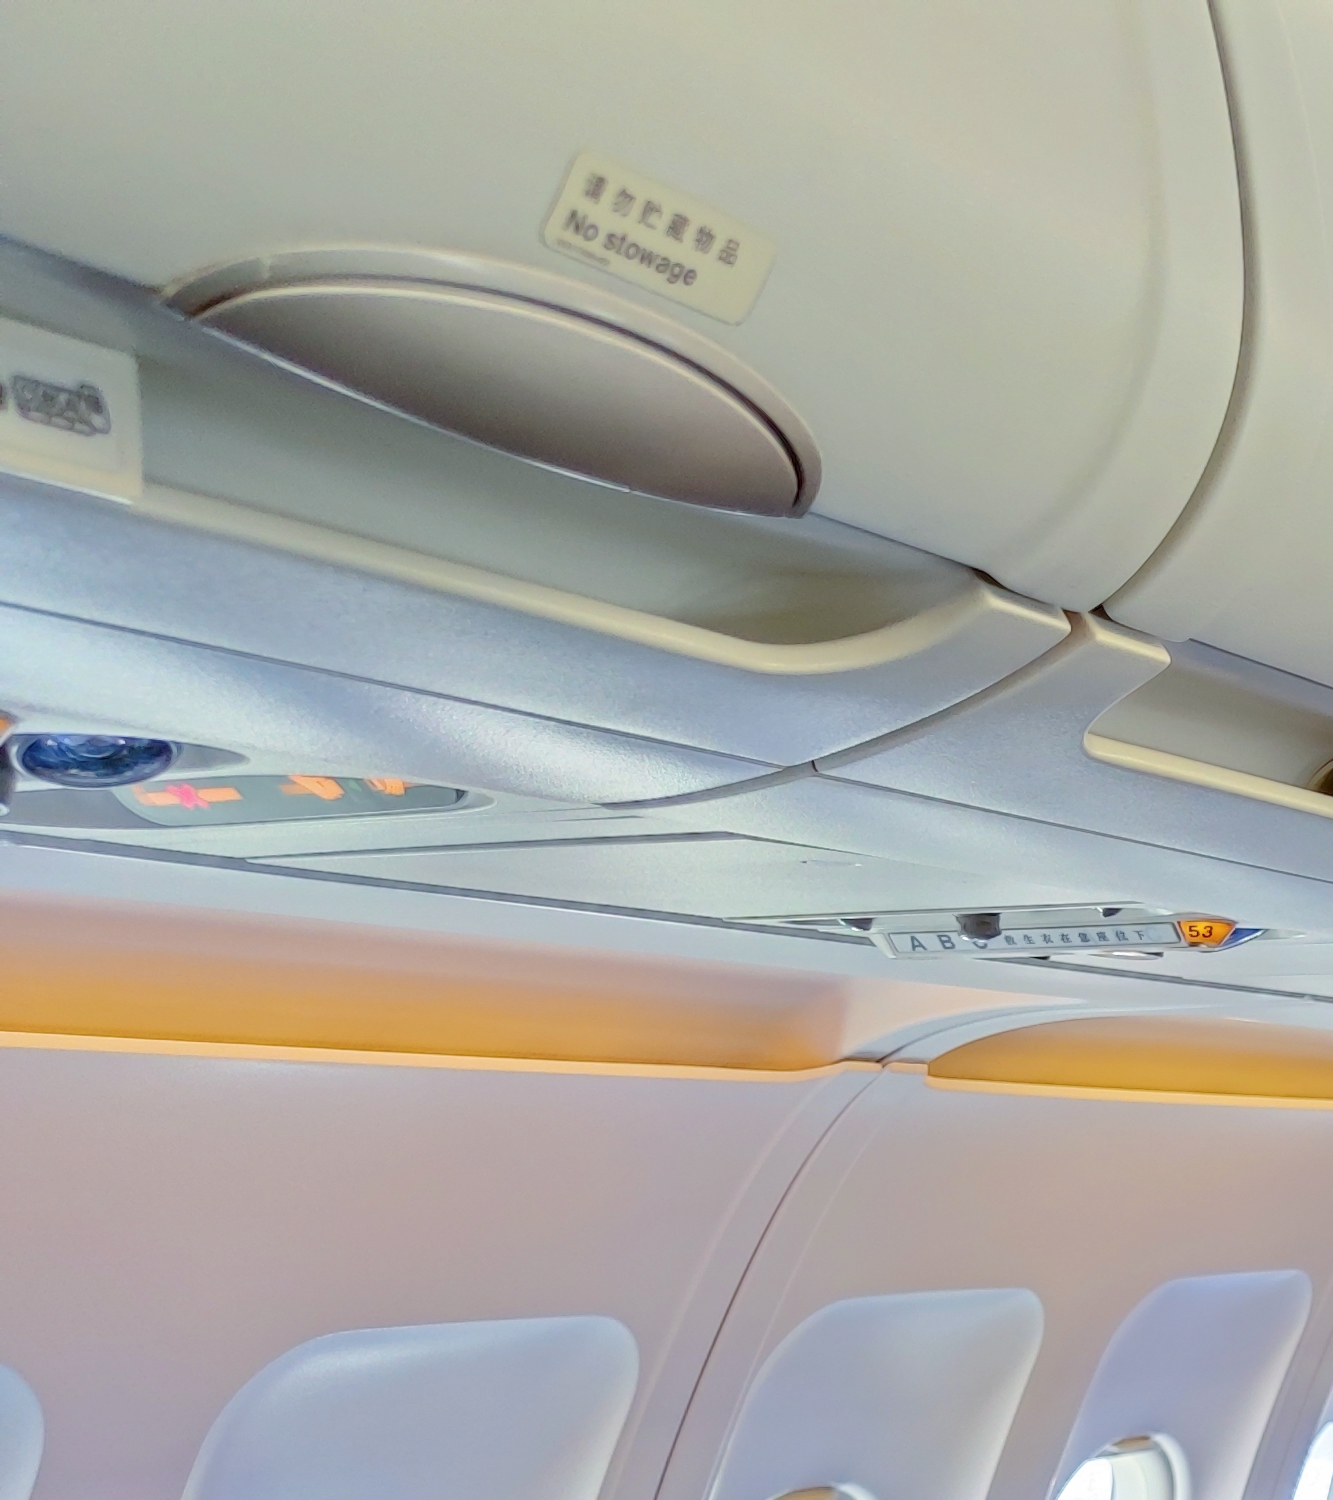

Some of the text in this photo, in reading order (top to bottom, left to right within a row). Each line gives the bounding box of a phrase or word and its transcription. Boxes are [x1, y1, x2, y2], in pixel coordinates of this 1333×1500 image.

[563, 209, 599, 241] No
[603, 232, 697, 286] stowage
[1188, 924, 1213, 939] 53
[909, 935, 927, 951] A
[940, 934, 956, 949] B
